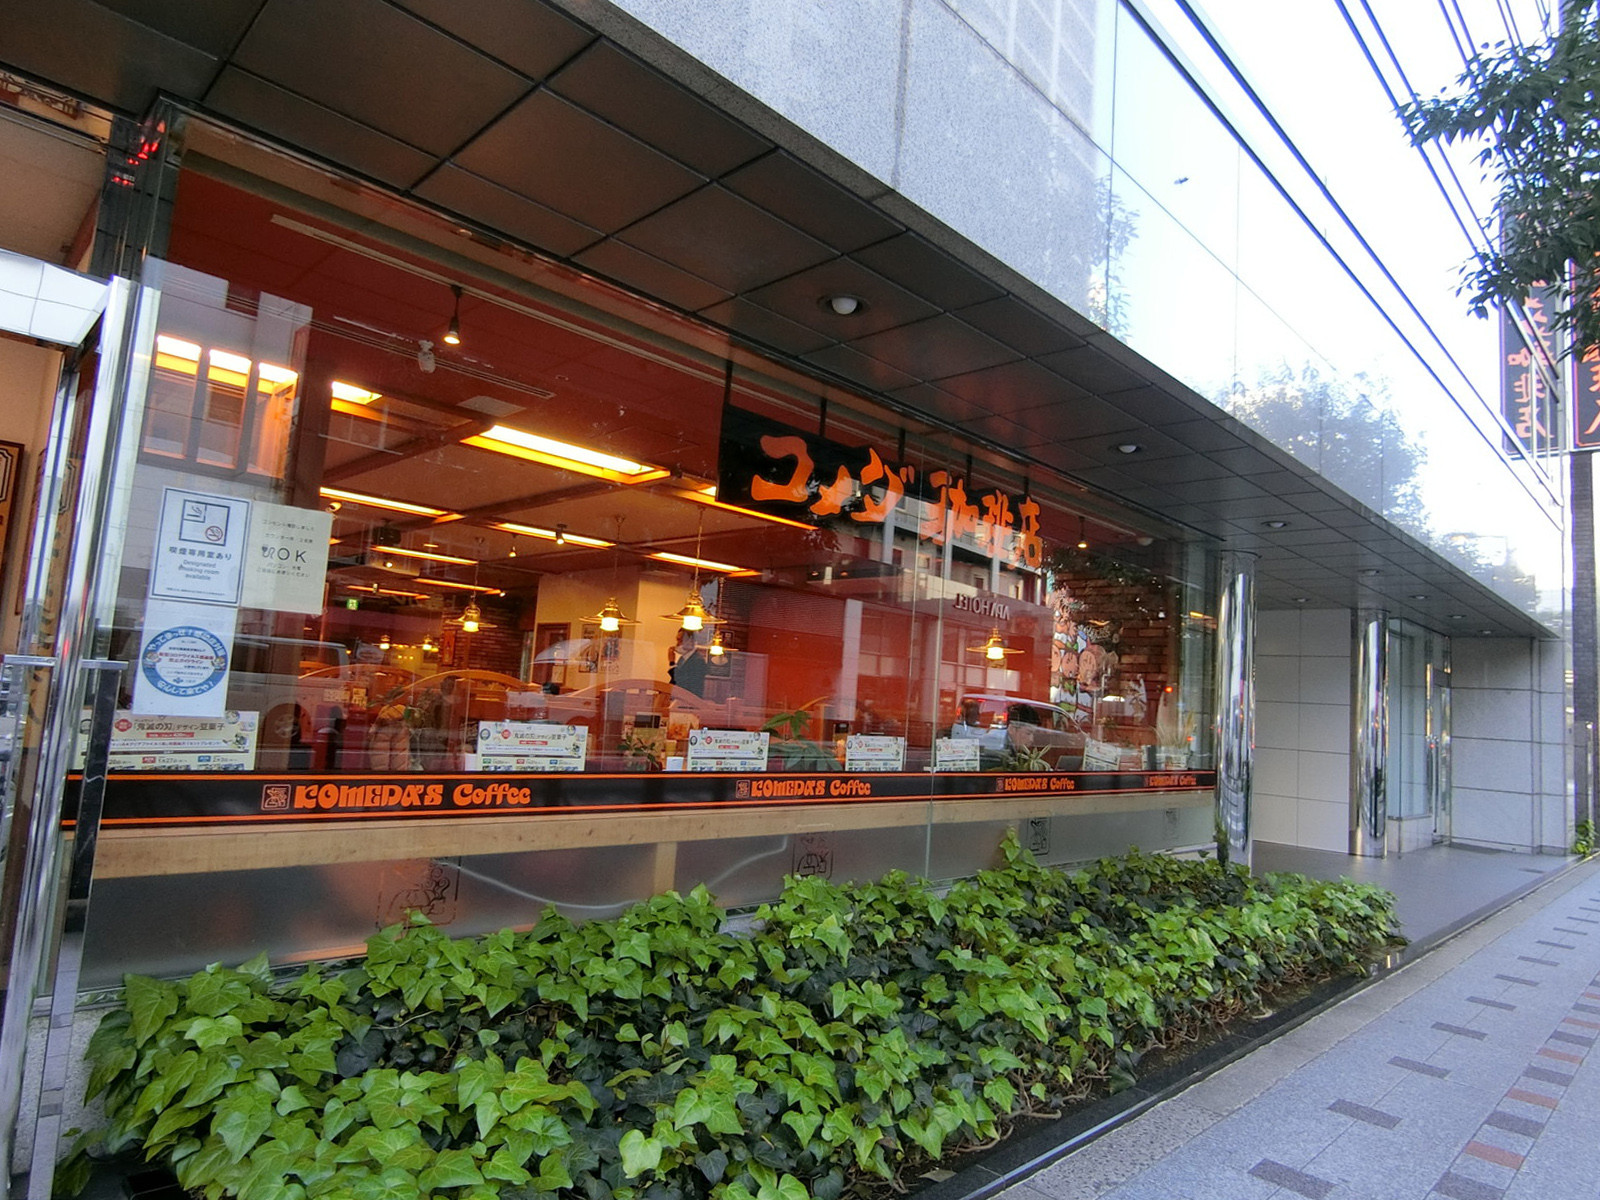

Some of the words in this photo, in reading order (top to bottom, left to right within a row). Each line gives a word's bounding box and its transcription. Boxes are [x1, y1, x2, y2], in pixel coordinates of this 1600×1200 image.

[751, 434, 1043, 570] コメダ珈琲店
[169, 546, 232, 560] 喫煙専用室あり
[183, 559, 216, 569] Designated
[829, 780, 871, 796] Coffee
[1050, 777, 1075, 790] Coffee
[294, 784, 443, 809] KOMEDA'S
[453, 784, 531, 806] Coffee
